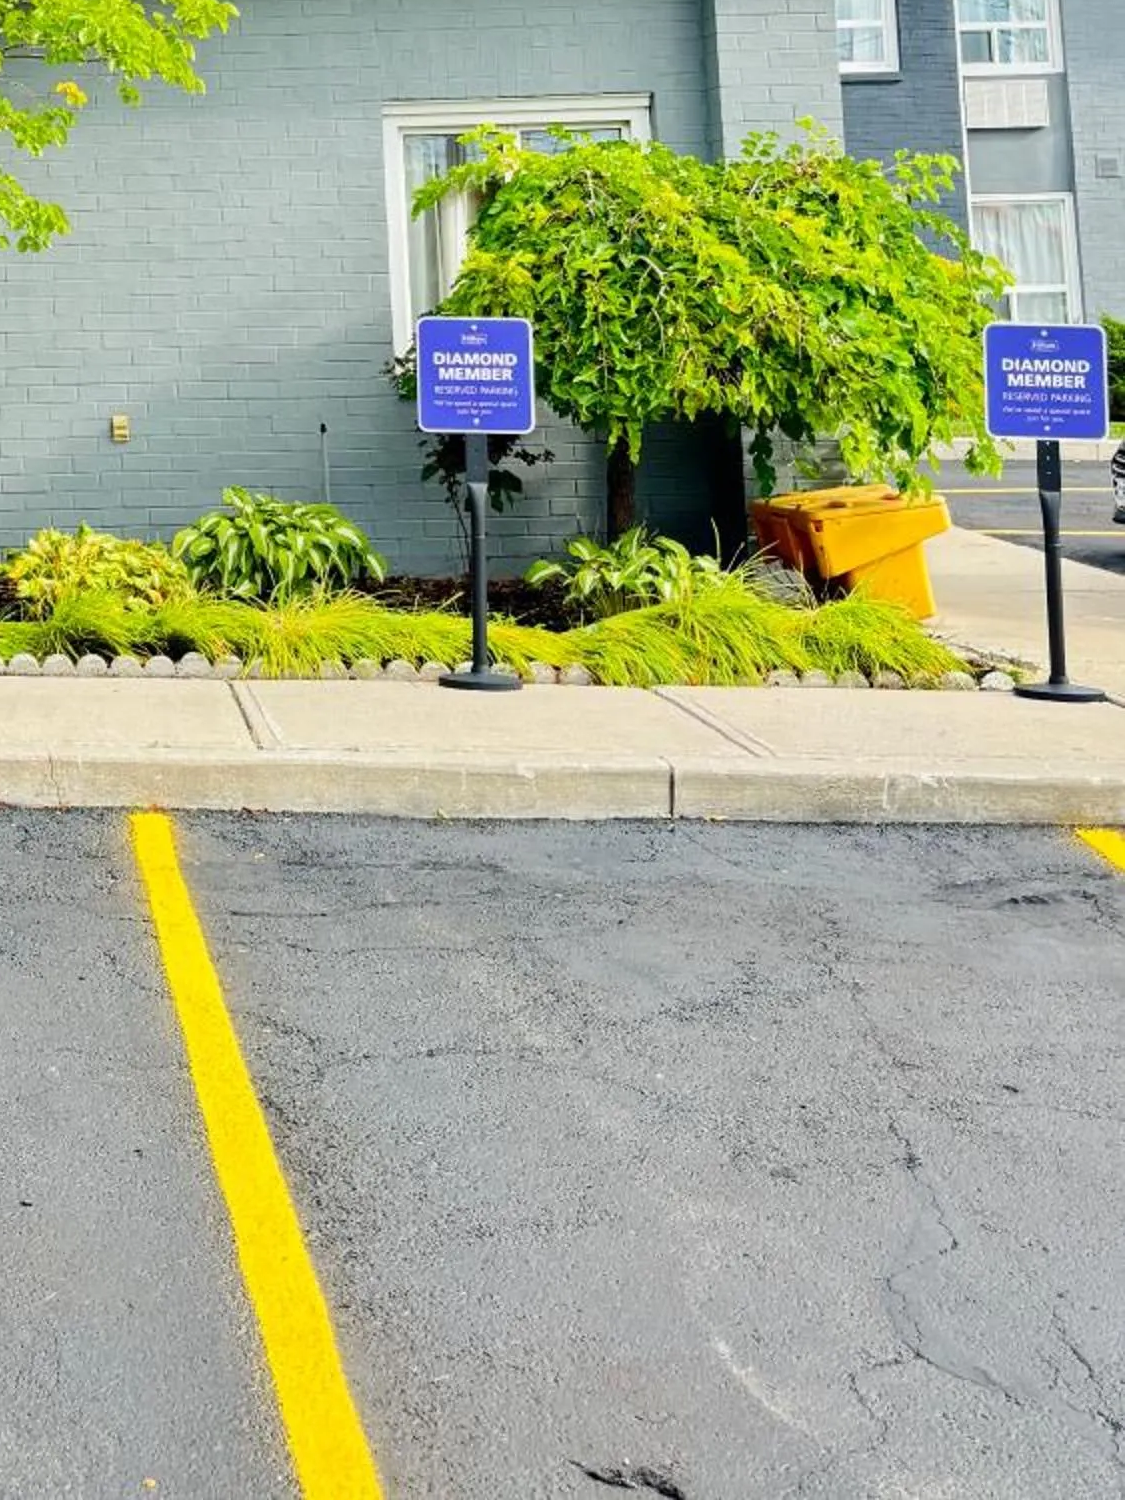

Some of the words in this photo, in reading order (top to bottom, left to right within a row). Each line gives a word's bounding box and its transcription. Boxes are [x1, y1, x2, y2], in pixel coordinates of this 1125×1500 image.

[433, 352, 518, 366] DIAMOND
[1001, 358, 1091, 373] DIAMOND
[438, 367, 514, 381] MEMBER
[1007, 373, 1086, 388] MEMBER
